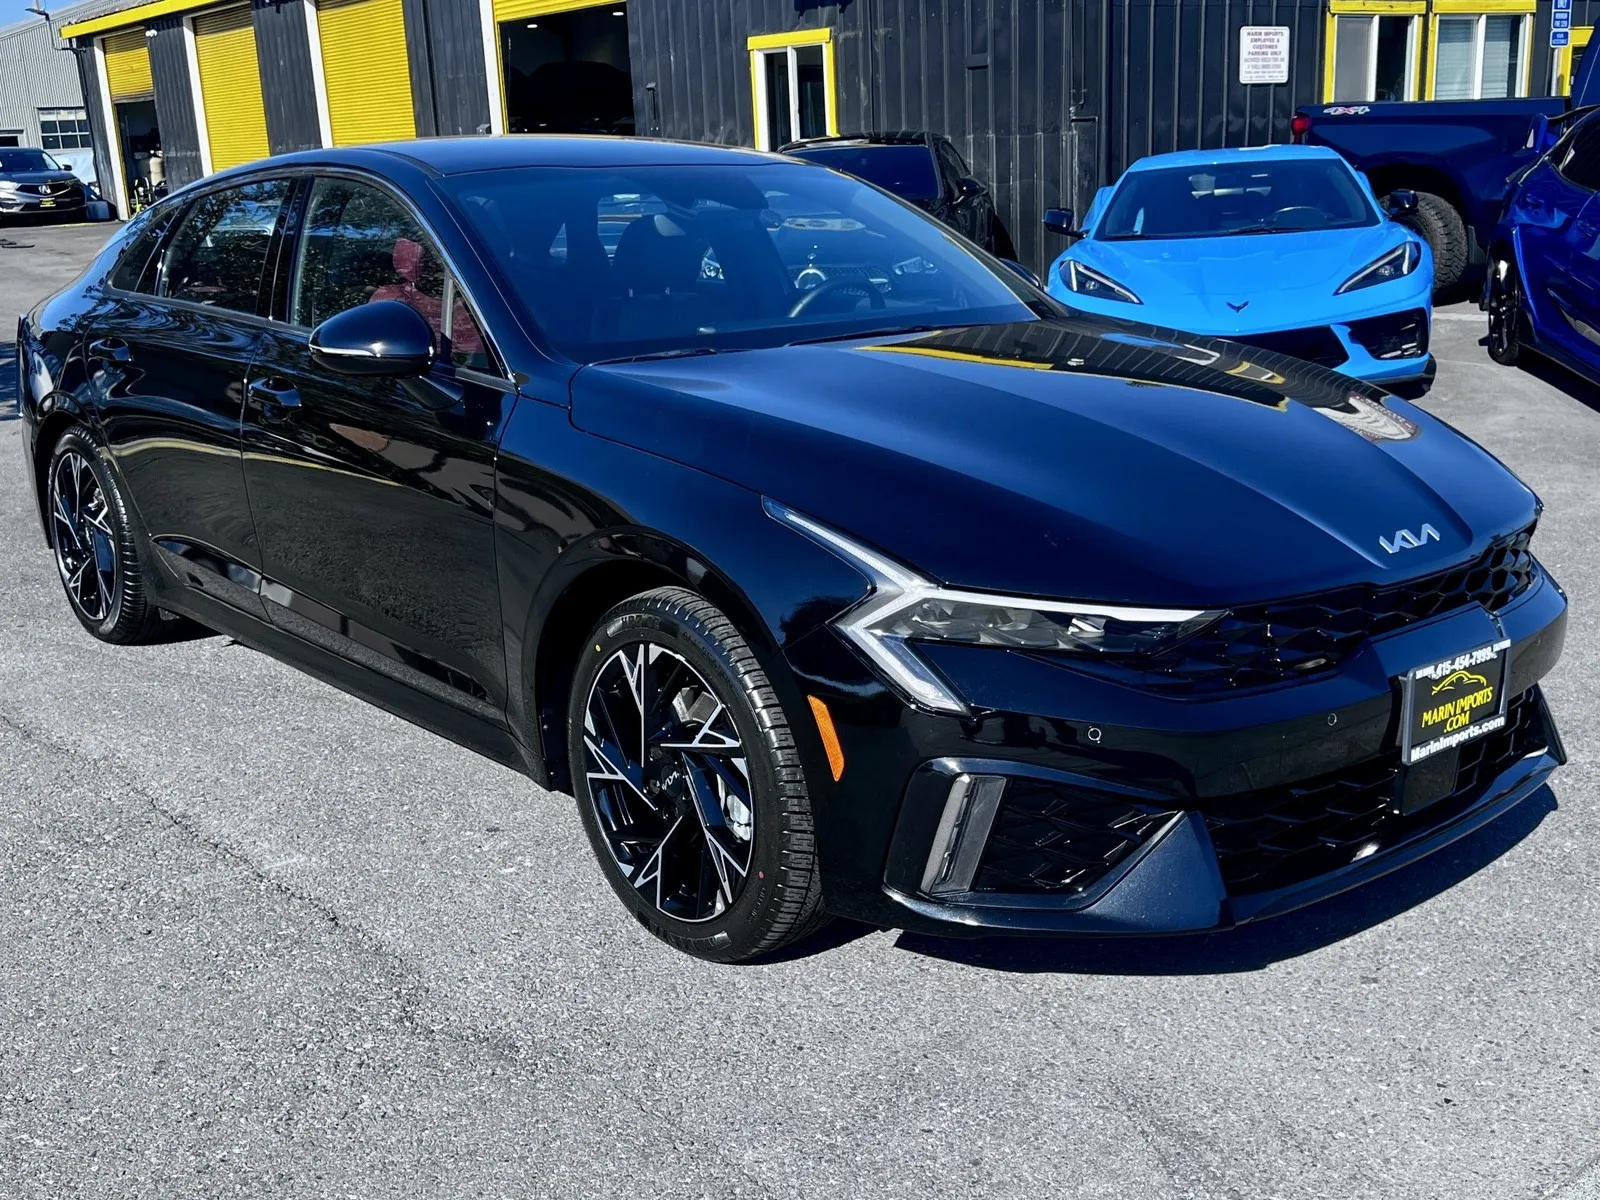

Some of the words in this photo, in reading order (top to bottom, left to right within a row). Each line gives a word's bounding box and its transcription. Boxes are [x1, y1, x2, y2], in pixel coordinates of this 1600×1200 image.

[1379, 523, 1440, 553] KIA
[1421, 701, 1456, 728] MARIN
[1455, 686, 1494, 715] IMPORTS
[1443, 711, 1470, 733] .COM
